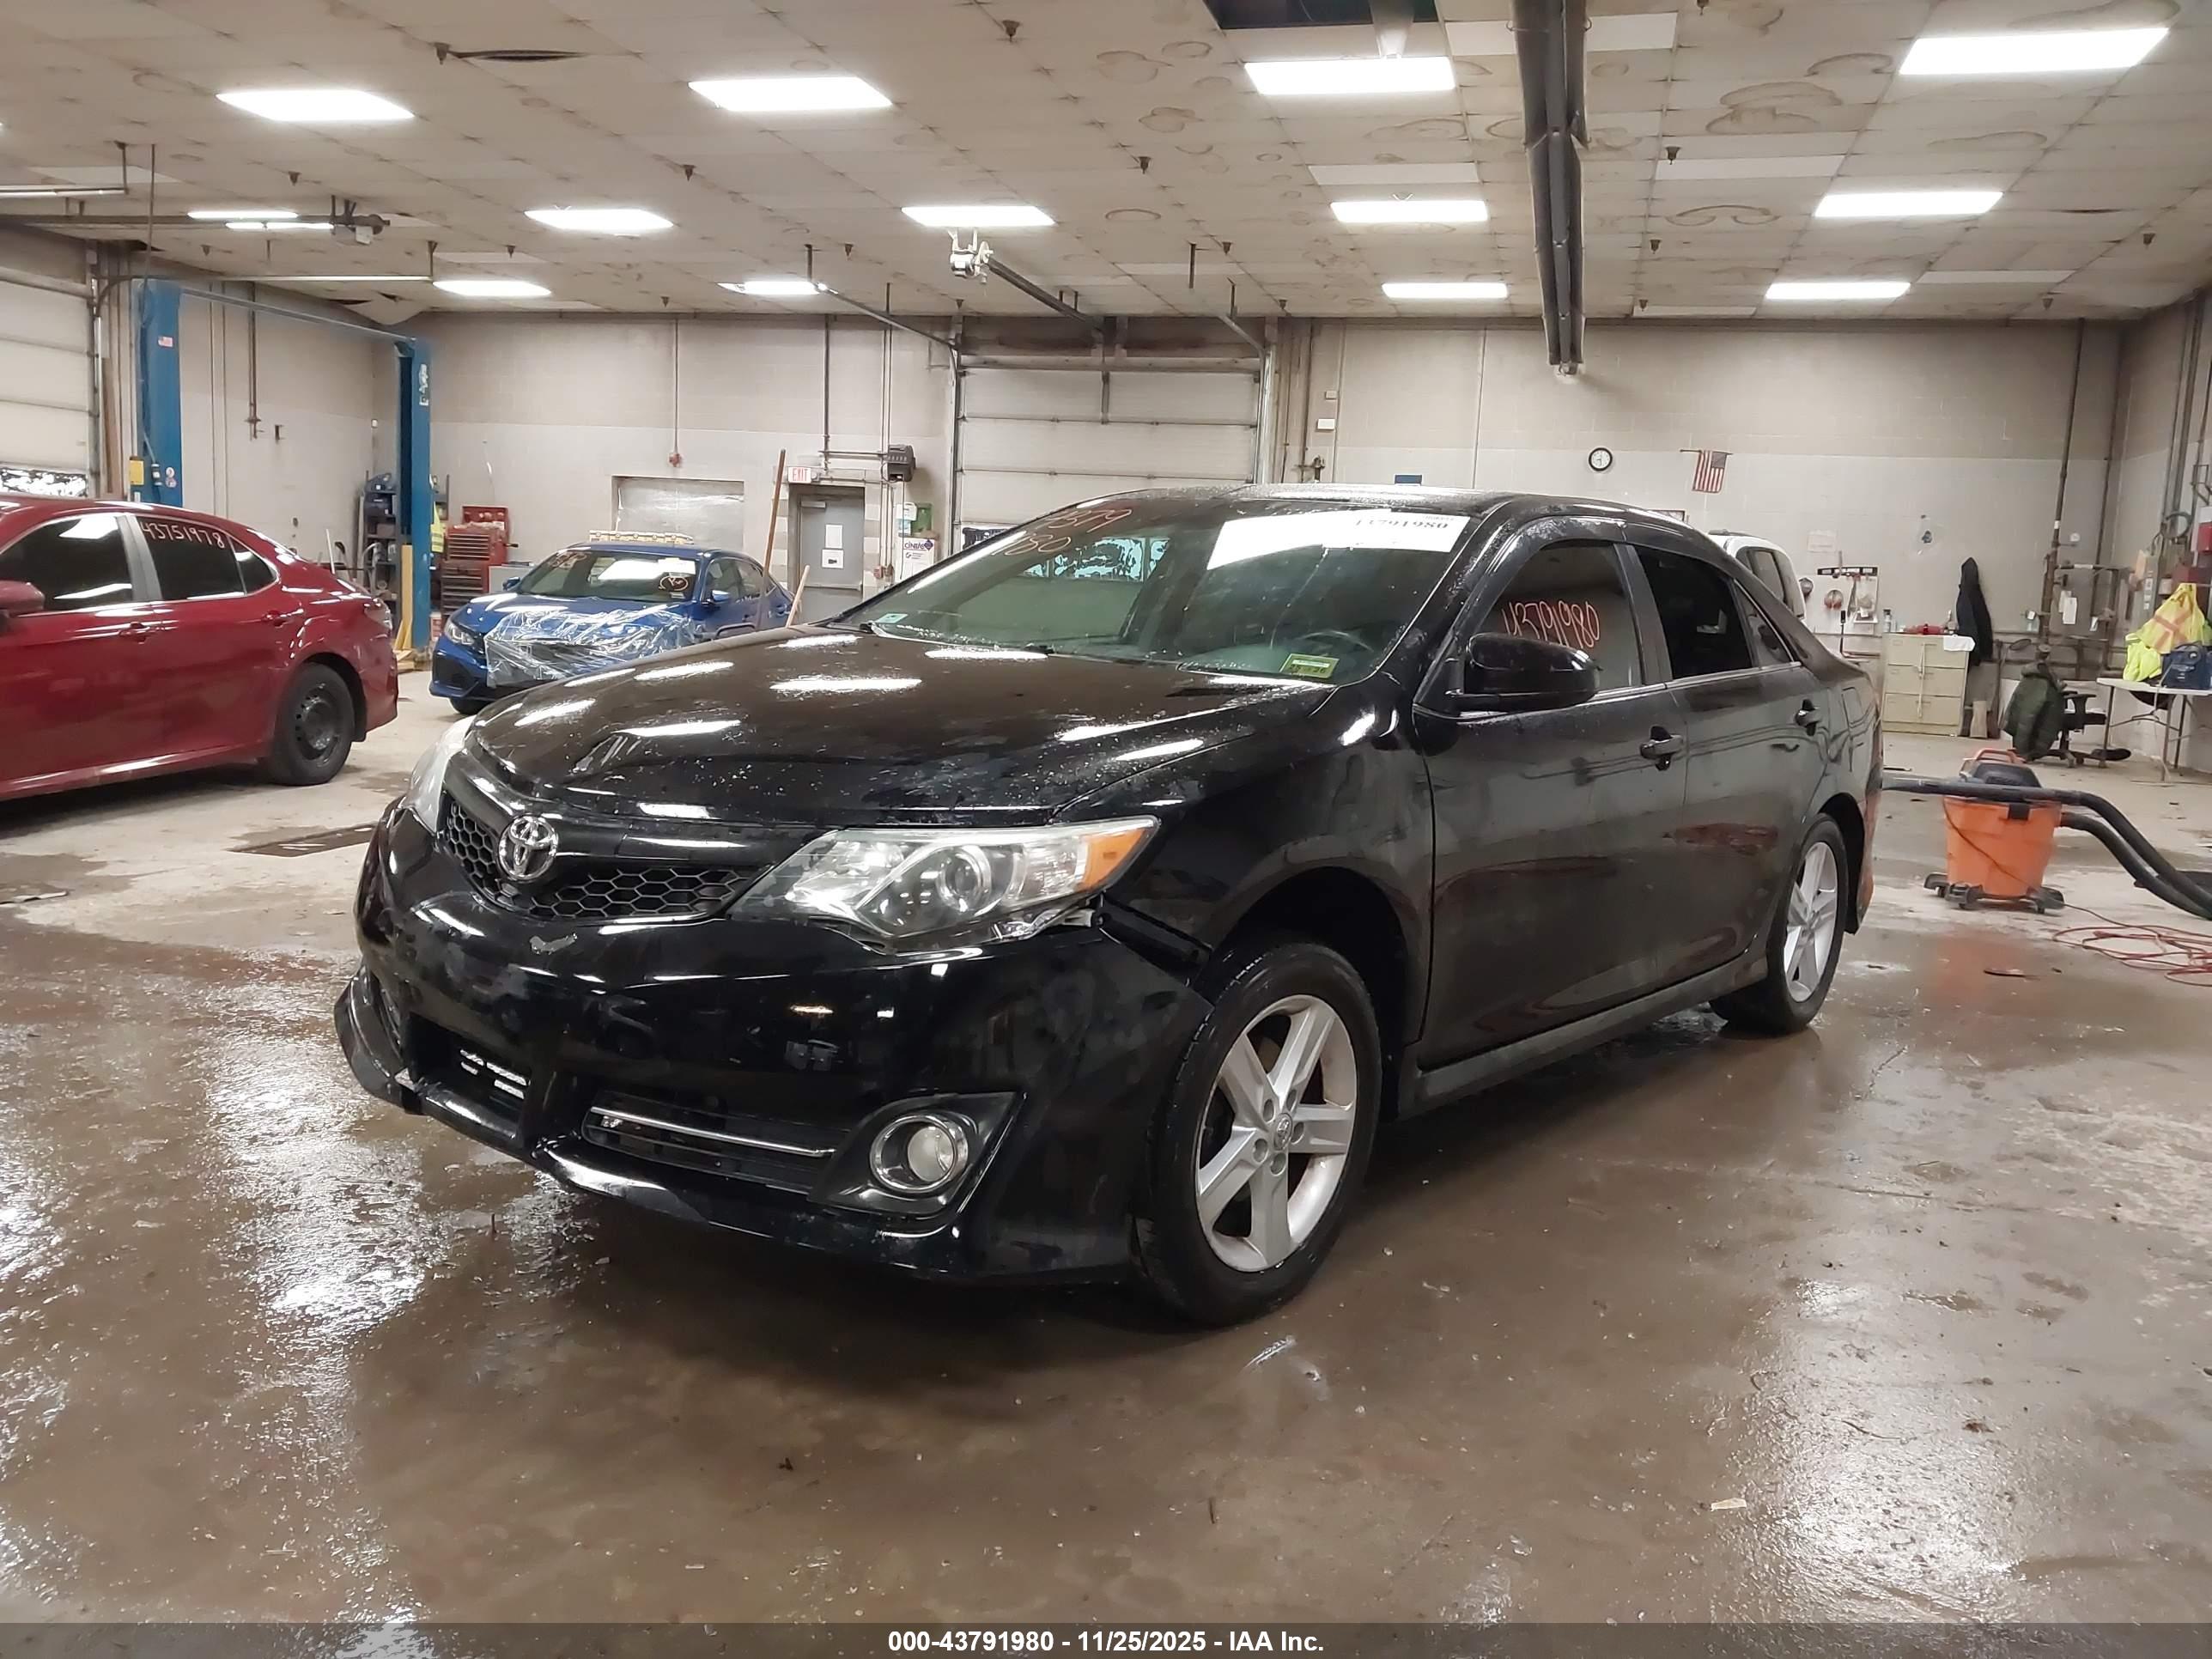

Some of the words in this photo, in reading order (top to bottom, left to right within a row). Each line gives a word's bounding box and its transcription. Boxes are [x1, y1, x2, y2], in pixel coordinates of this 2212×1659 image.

[793, 468, 809, 482] EXIT
[140, 521, 225, 549] 43751978
[1501, 600, 1601, 649] 43791980
